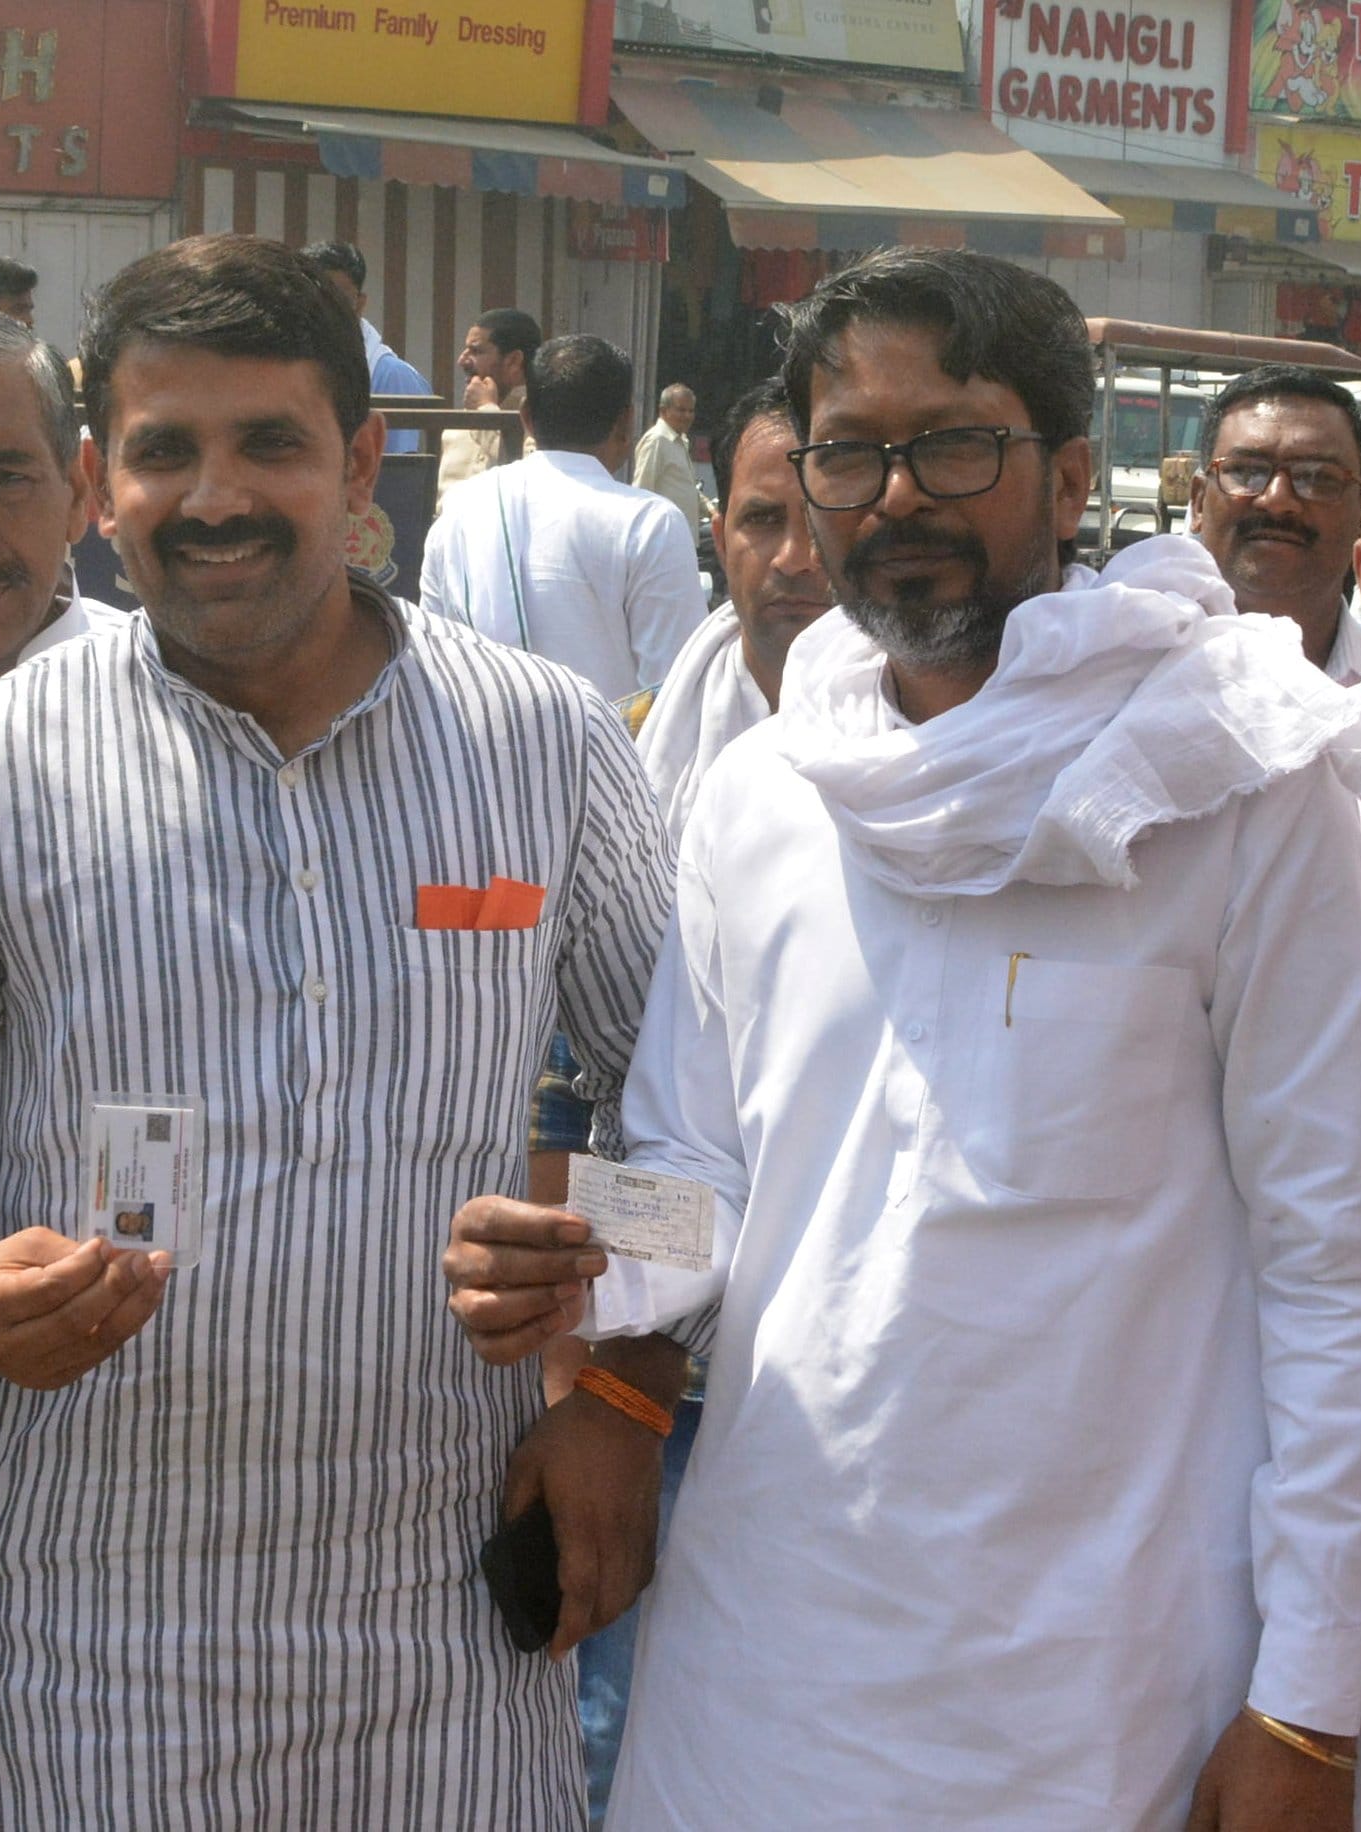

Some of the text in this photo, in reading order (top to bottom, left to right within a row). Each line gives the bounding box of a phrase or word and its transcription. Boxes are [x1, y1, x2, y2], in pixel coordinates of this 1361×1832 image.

[264, 0, 546, 55] Premium Family Dressing
[1028, 3, 1195, 70] NANGLI
[998, 67, 1216, 136] GARMENTS
